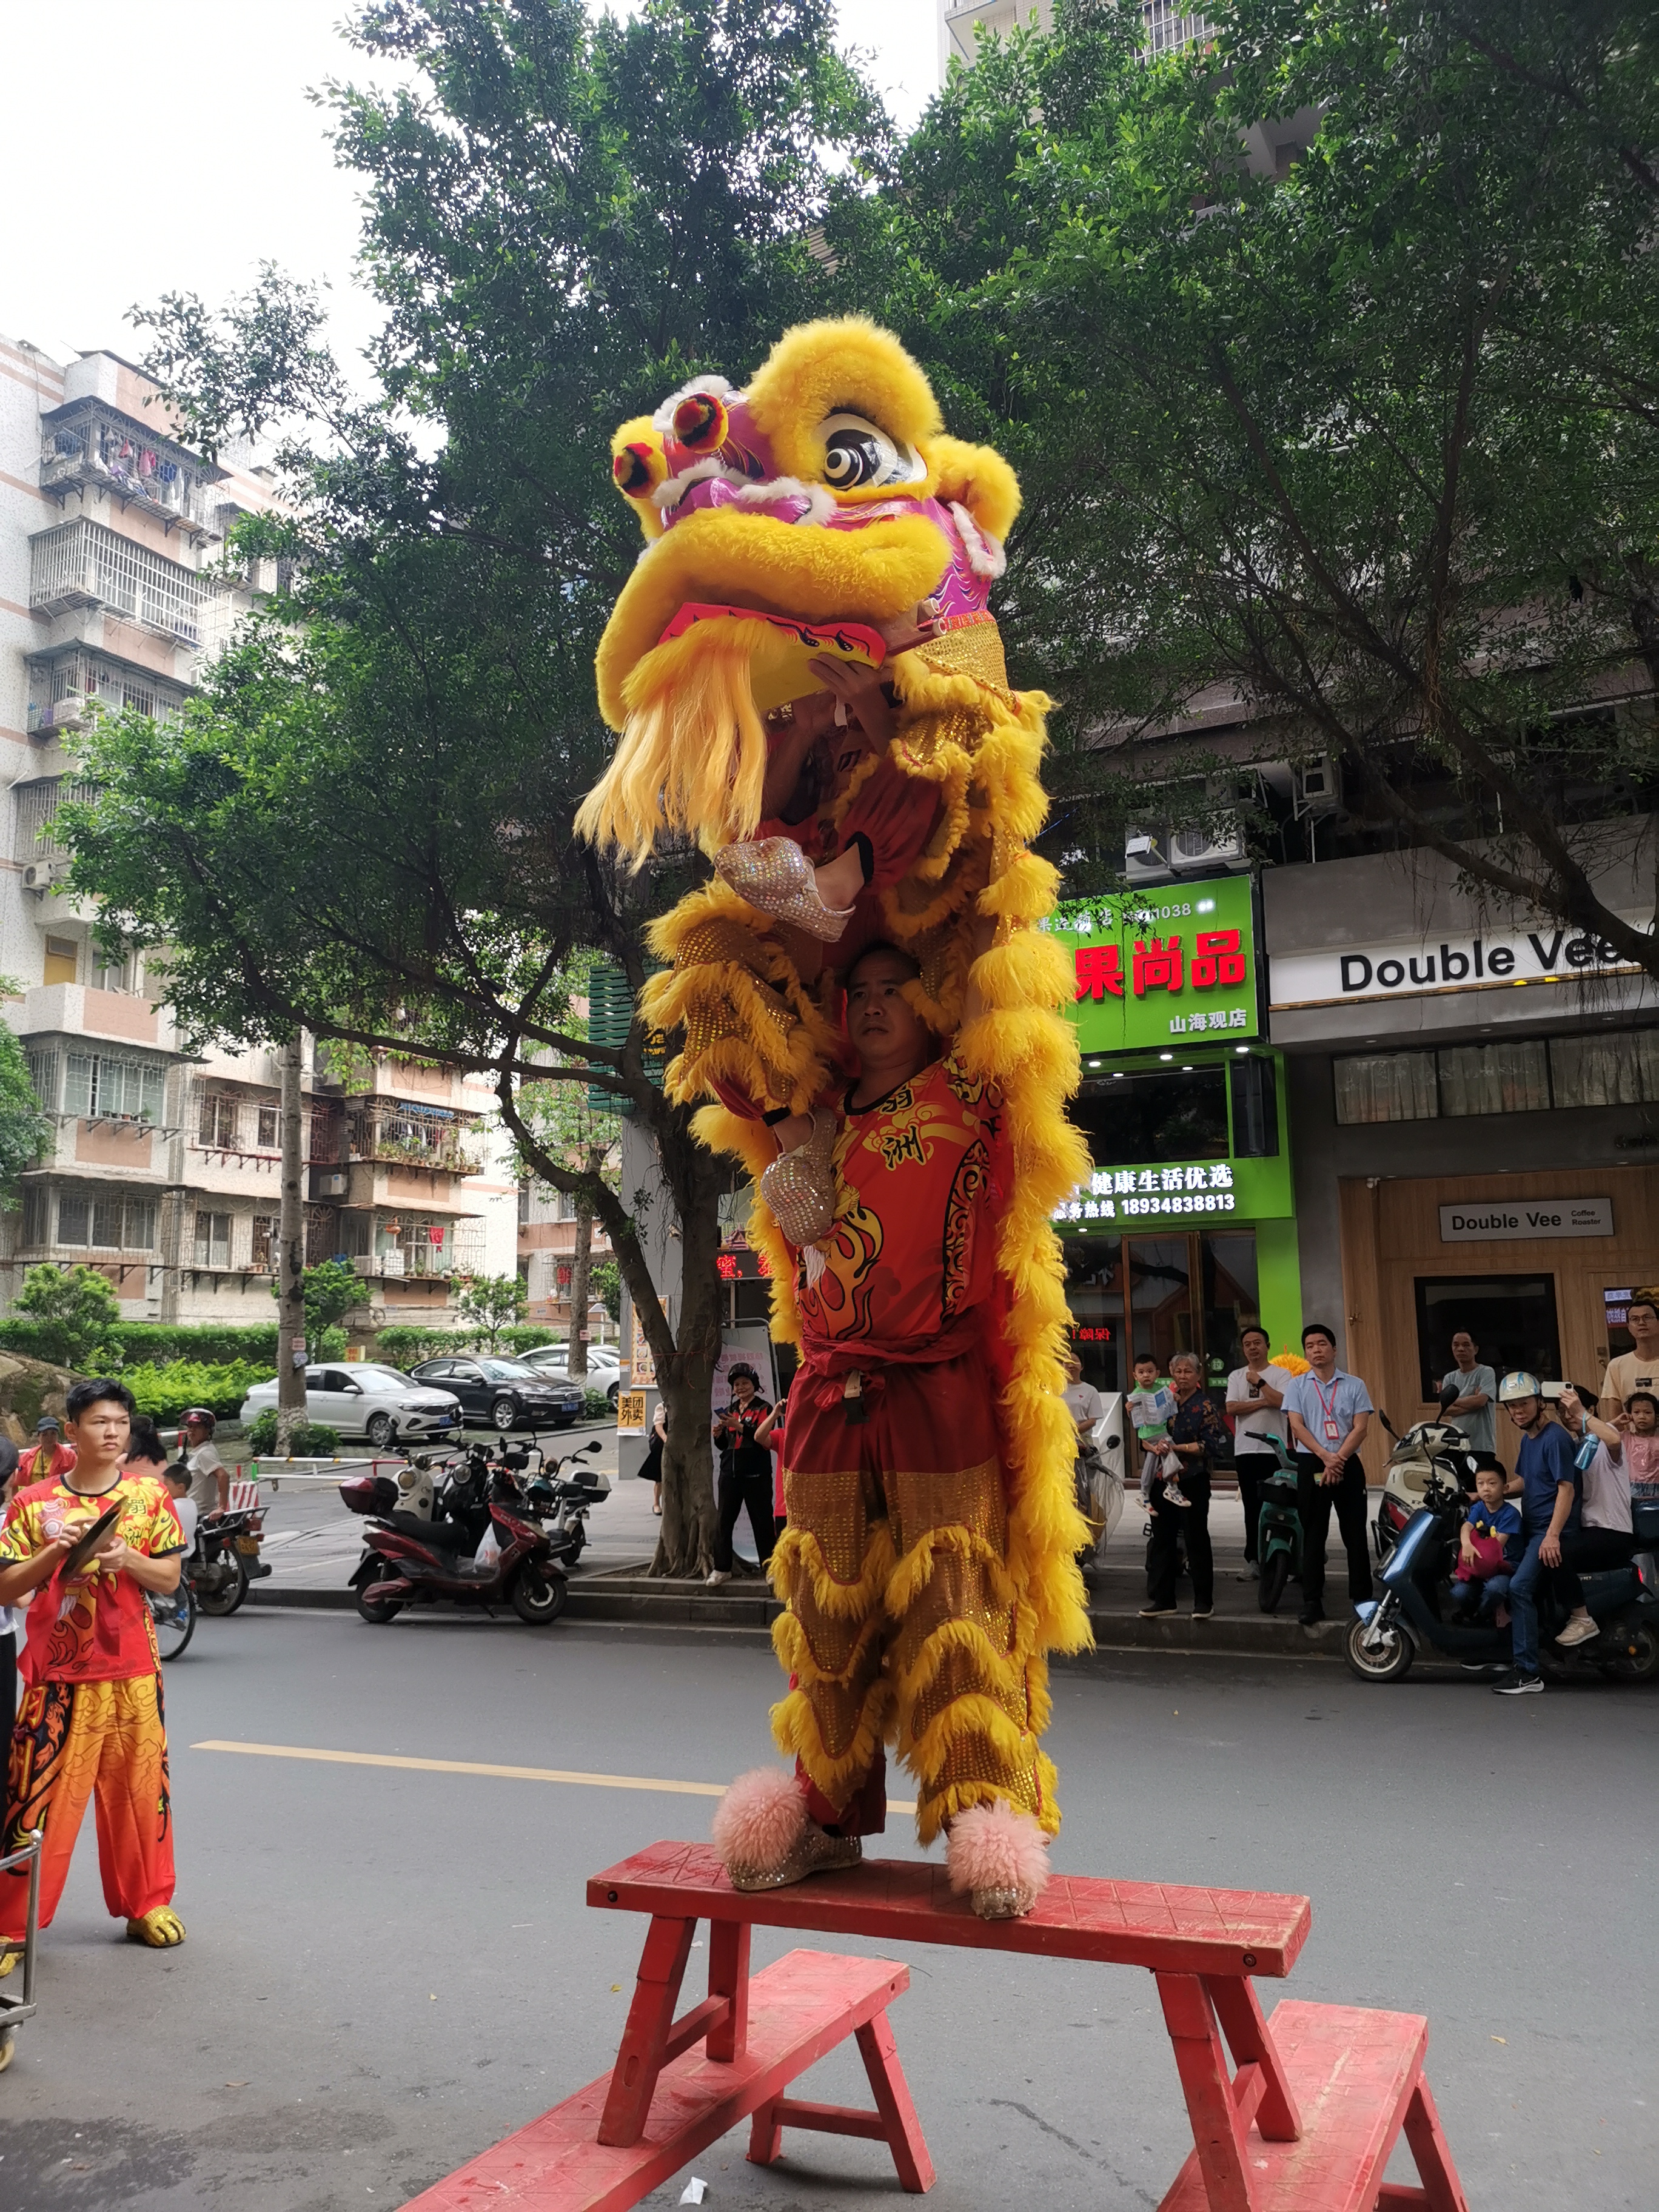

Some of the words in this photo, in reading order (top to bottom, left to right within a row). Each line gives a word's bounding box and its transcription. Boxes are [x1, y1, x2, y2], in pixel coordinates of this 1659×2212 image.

[1075, 928, 1245, 999] 果尚品
[1341, 940, 1515, 991] Double
[1527, 931, 1627, 970] Vee
[1170, 1008, 1247, 1033] 山海观店
[1091, 1164, 1233, 1195] 健康生活优选
[1053, 1200, 1116, 1221] 服务热线
[1121, 1193, 1235, 1215] 18934838813
[1452, 1214, 1519, 1230] Double
[1526, 1212, 1561, 1227] Vee
[621, 1396, 644, 1409] 美团
[620, 1409, 643, 1426] 外卖
